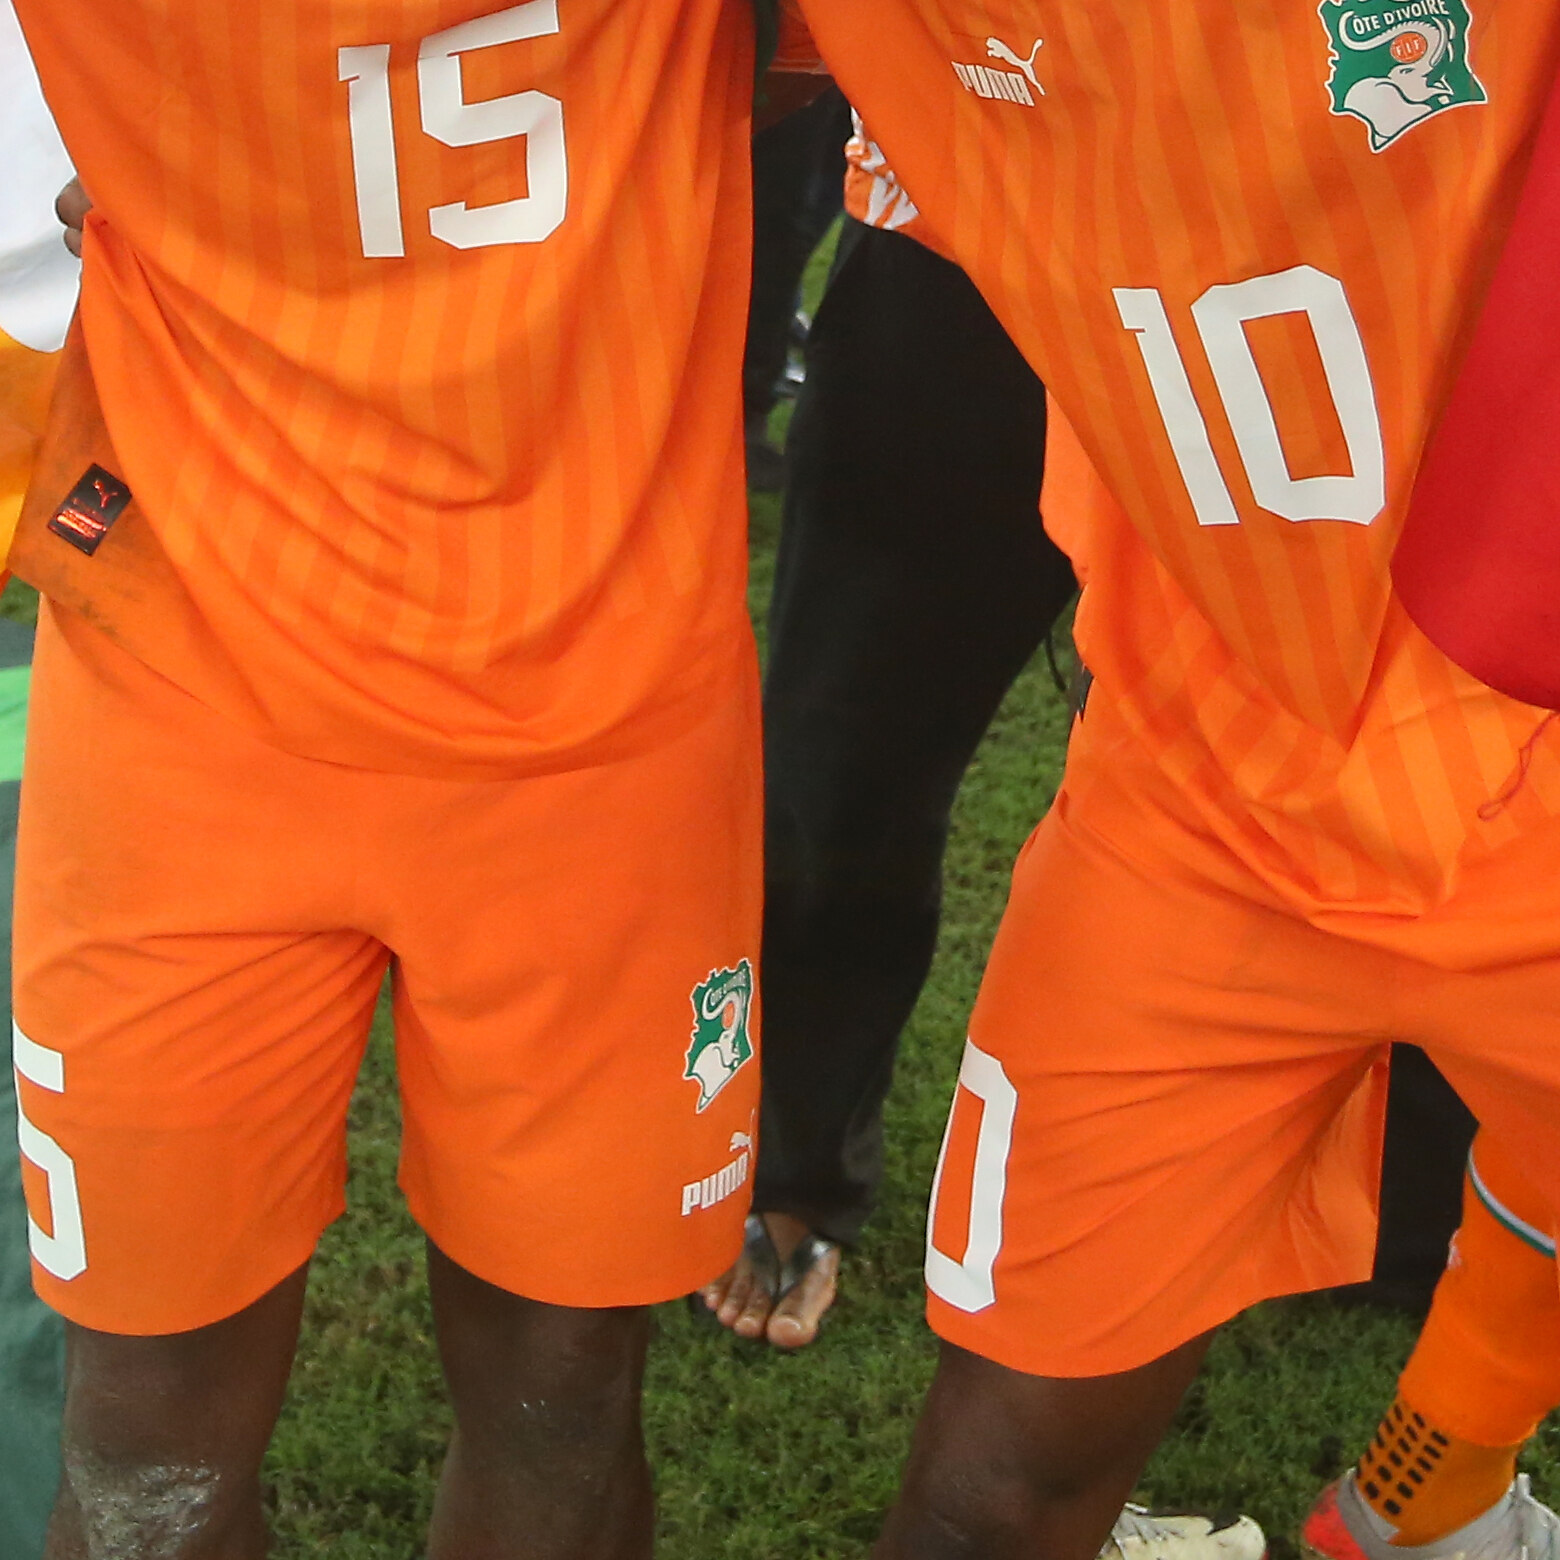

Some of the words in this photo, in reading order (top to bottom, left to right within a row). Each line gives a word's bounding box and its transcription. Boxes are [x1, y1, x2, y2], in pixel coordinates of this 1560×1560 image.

[1395, 38, 1421, 57] FIF
[951, 61, 1035, 107] PUMA
[1112, 263, 1386, 526] 10
[681, 1152, 748, 1217] PUMA
